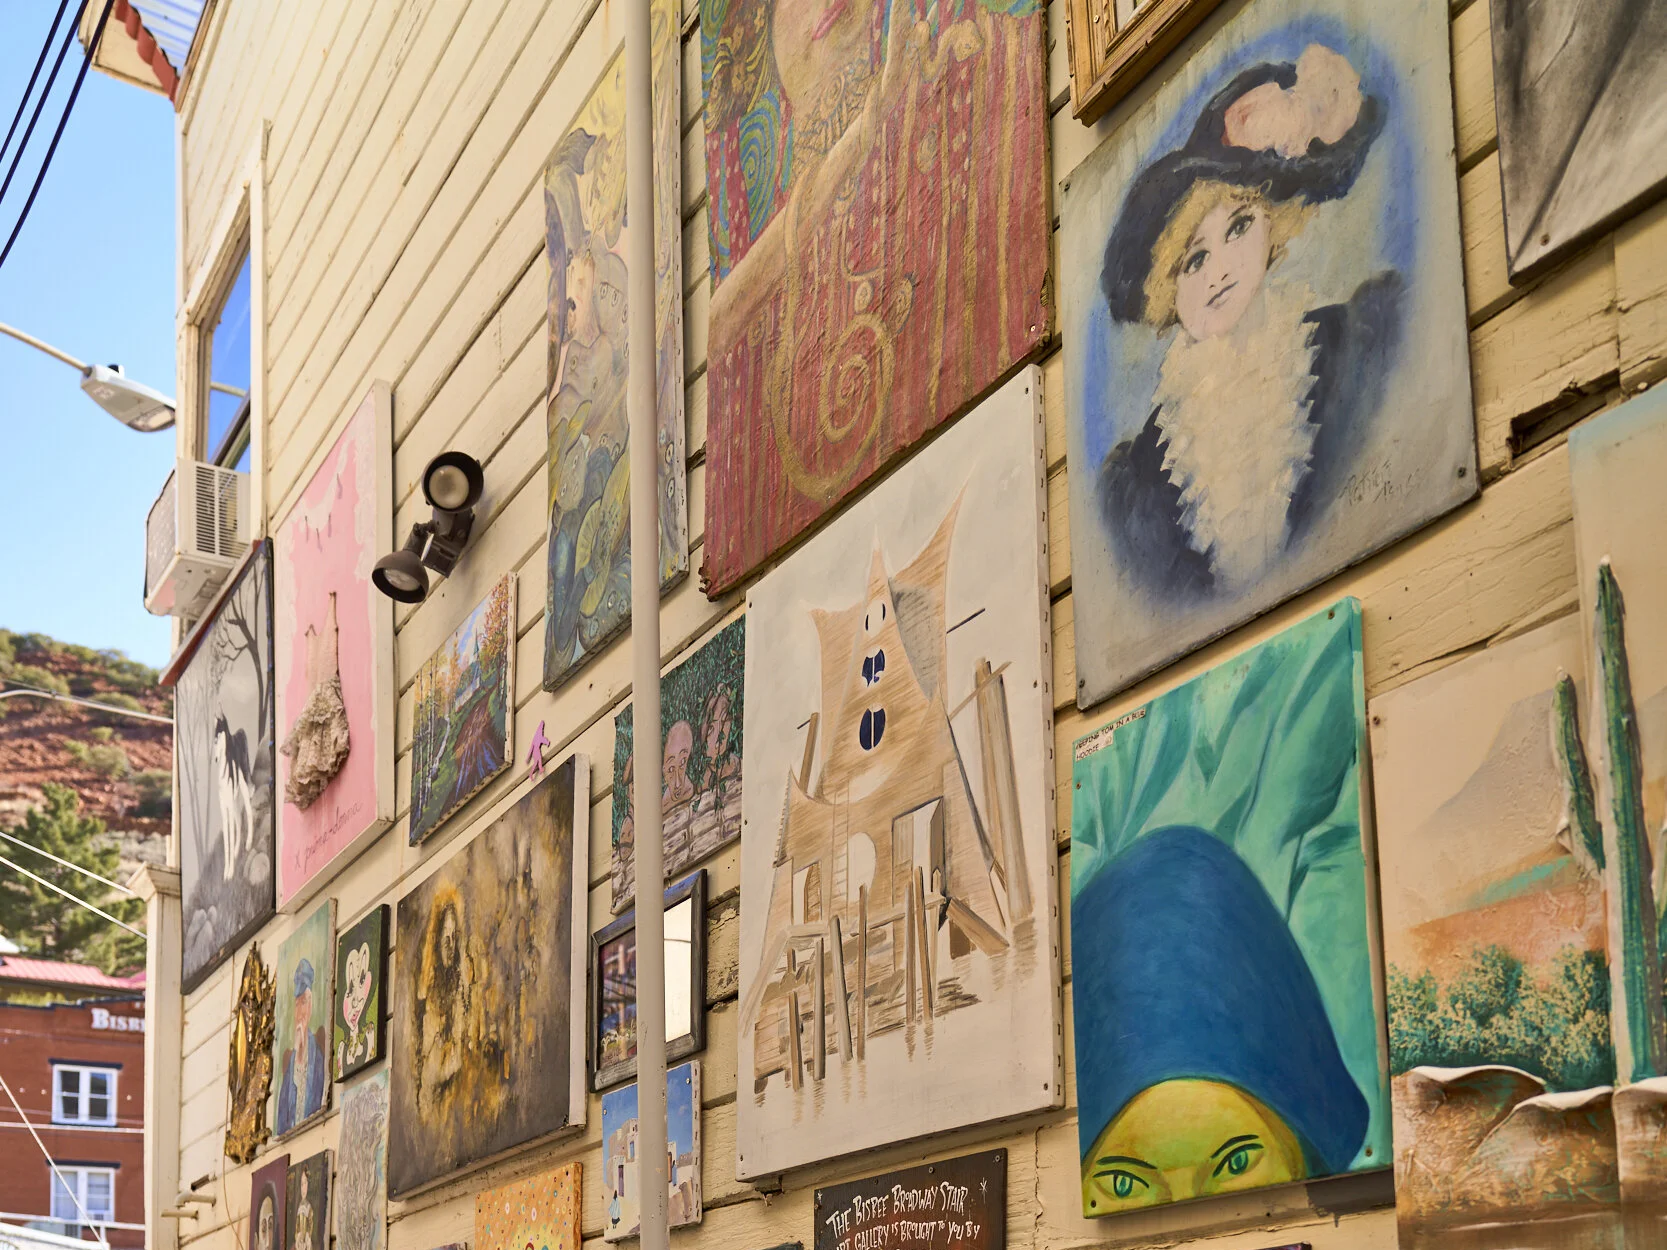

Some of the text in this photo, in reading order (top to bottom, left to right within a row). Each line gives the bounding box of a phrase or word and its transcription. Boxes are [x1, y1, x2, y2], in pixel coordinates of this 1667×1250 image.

[1101, 725, 1114, 736] TOM
[1116, 720, 1124, 728] IN
[1076, 743, 1099, 760] HOODIE
[826, 1181, 968, 1239] THE BISBEE BROADWAY STAIR
[891, 1222, 899, 1236] IS
[900, 1220, 936, 1242] BROUGHT
[938, 1220, 946, 1231] TO
[948, 1221, 964, 1244] YOU
[965, 1221, 980, 1240] BY
